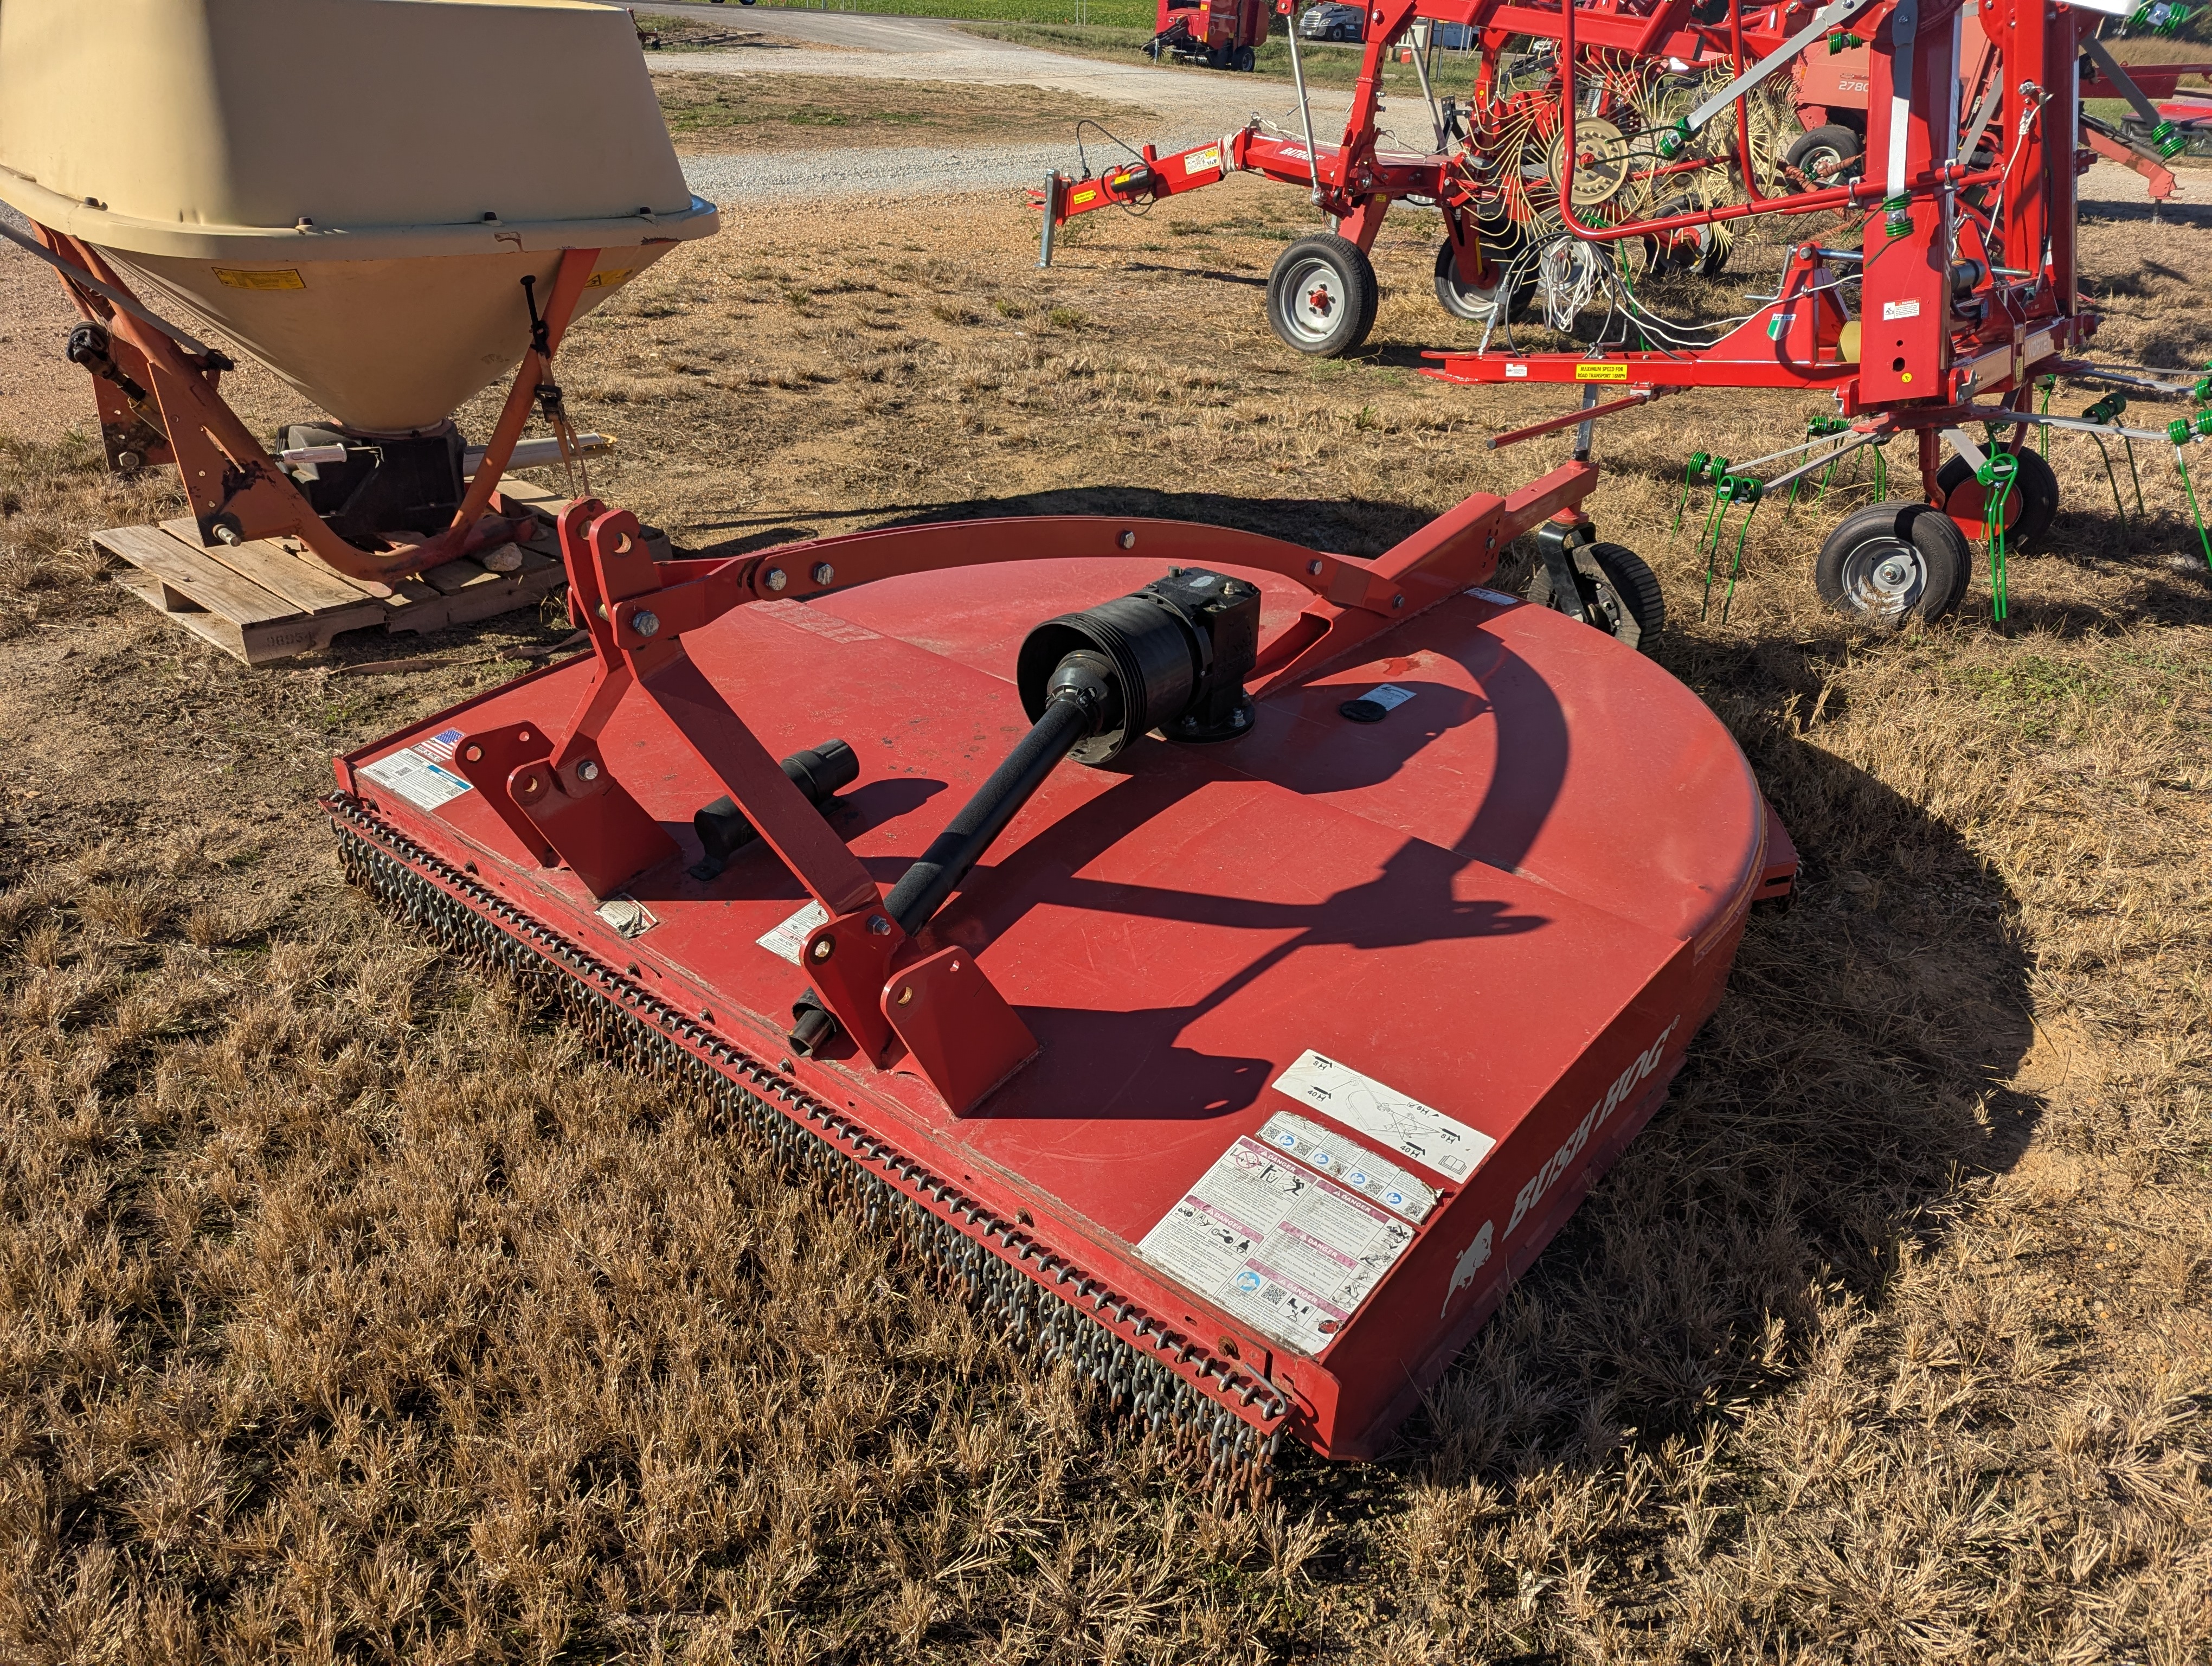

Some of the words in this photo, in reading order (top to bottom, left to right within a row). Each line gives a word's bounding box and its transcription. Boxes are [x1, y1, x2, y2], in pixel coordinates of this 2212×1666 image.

[1838, 80, 1869, 92] 2780
[439, 771, 459, 783] IMPORTANT
[607, 912, 618, 920] HERE
[1307, 1089, 1317, 1098] 40
[1399, 1145, 1411, 1154] 40
[1268, 1155, 1296, 1172] DANGER
[1502, 1098, 1602, 1243] BUSH
[1232, 1166, 1249, 1177] THROWN
[1249, 1175, 1267, 1187] OBJECTS
[1266, 1185, 1283, 1196] HAZARD
[1323, 1193, 1355, 1213] ENTANGLEMENT
[1355, 1211, 1373, 1222] HAZARD
[1342, 1195, 1371, 1213] DANGER
[1212, 1211, 1243, 1231] DANGER
[1193, 1230, 1206, 1239] Hazard
[1207, 1239, 1219, 1247] Death
[1222, 1247, 1233, 1255] Injury
[1283, 1232, 1301, 1244] Crushing
[1300, 1242, 1314, 1251] Hazard
[1330, 1260, 1342, 1268] Injury
[1308, 1239, 1338, 1258] DANGER
[1287, 1283, 1318, 1303] DANGER
